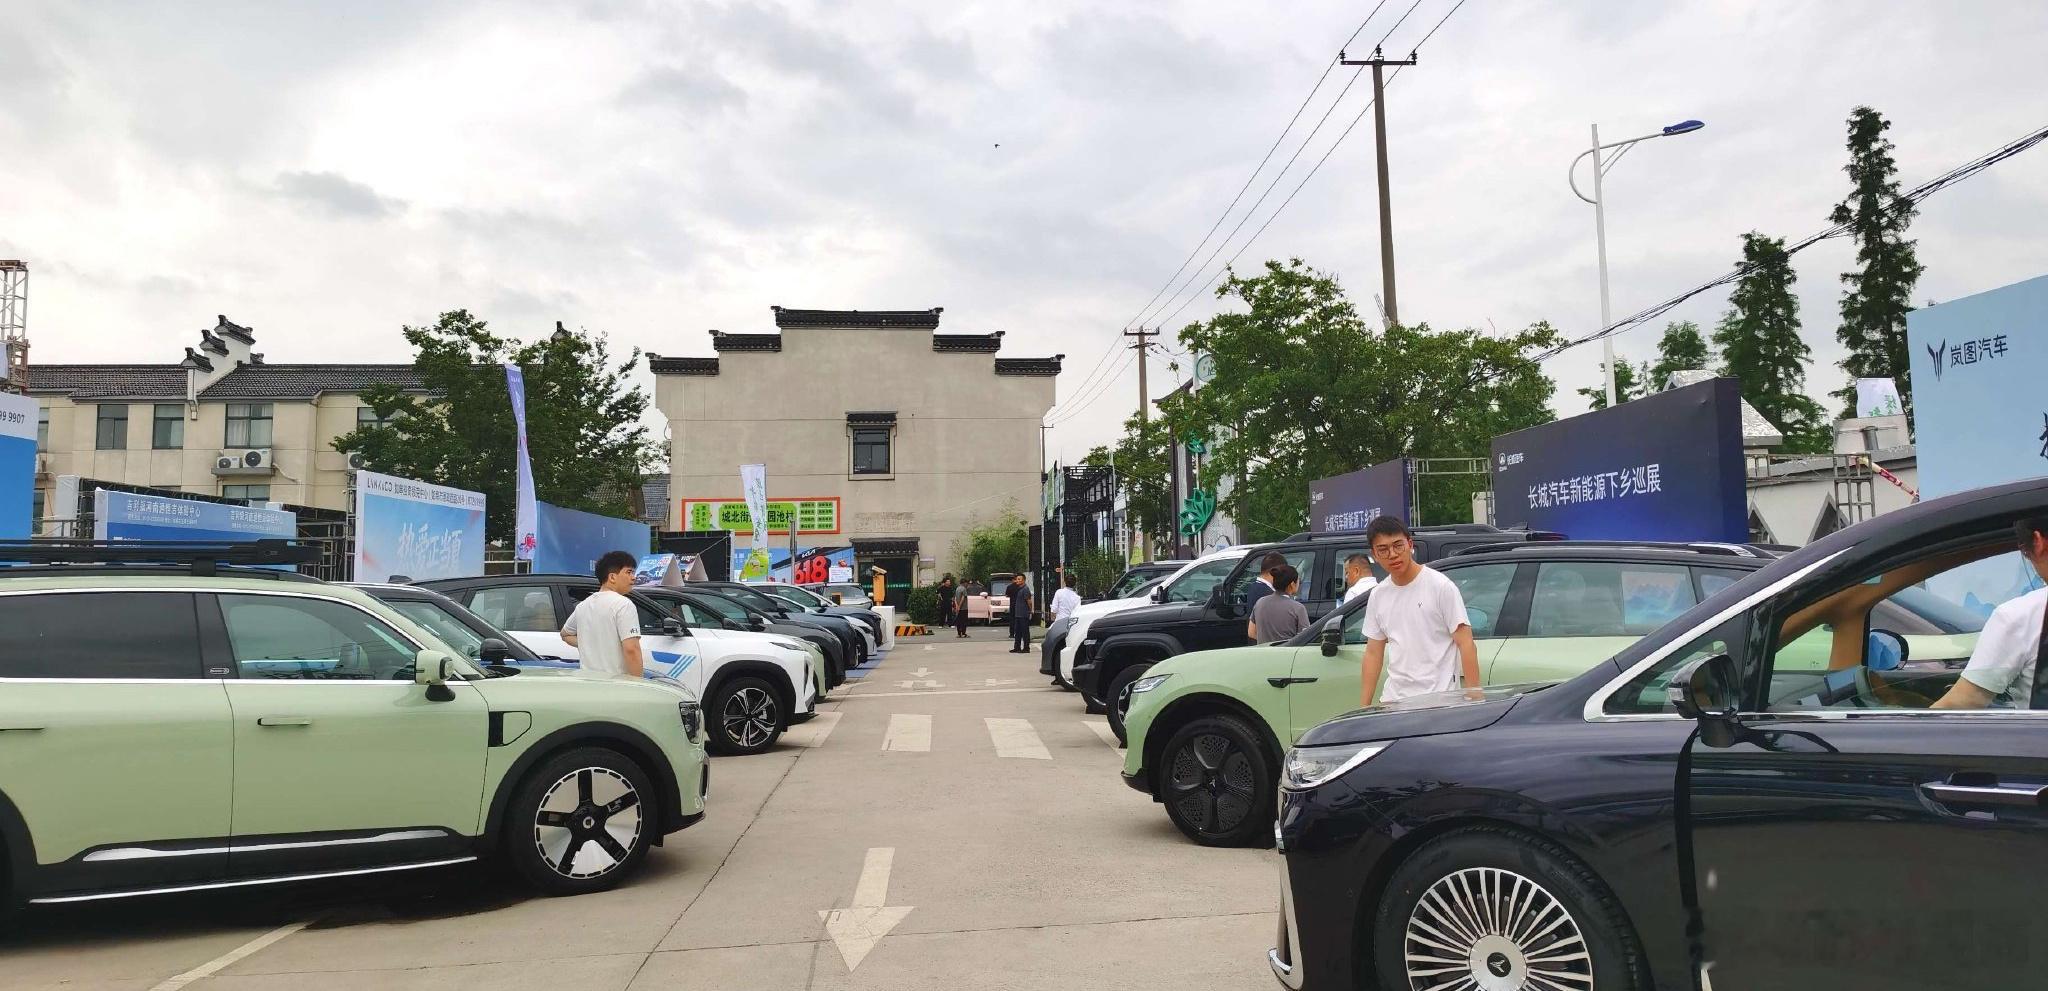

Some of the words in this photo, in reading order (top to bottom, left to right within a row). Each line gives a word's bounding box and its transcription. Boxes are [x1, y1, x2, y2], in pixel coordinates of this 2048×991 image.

[1950, 333, 2008, 368] 岚图汽车
[9, 411, 25, 424] 9907
[1527, 463, 1662, 510] 长城汽车新能源下乡巡展
[722, 510, 794, 523] 城北街园池村
[794, 556, 827, 584] 618
